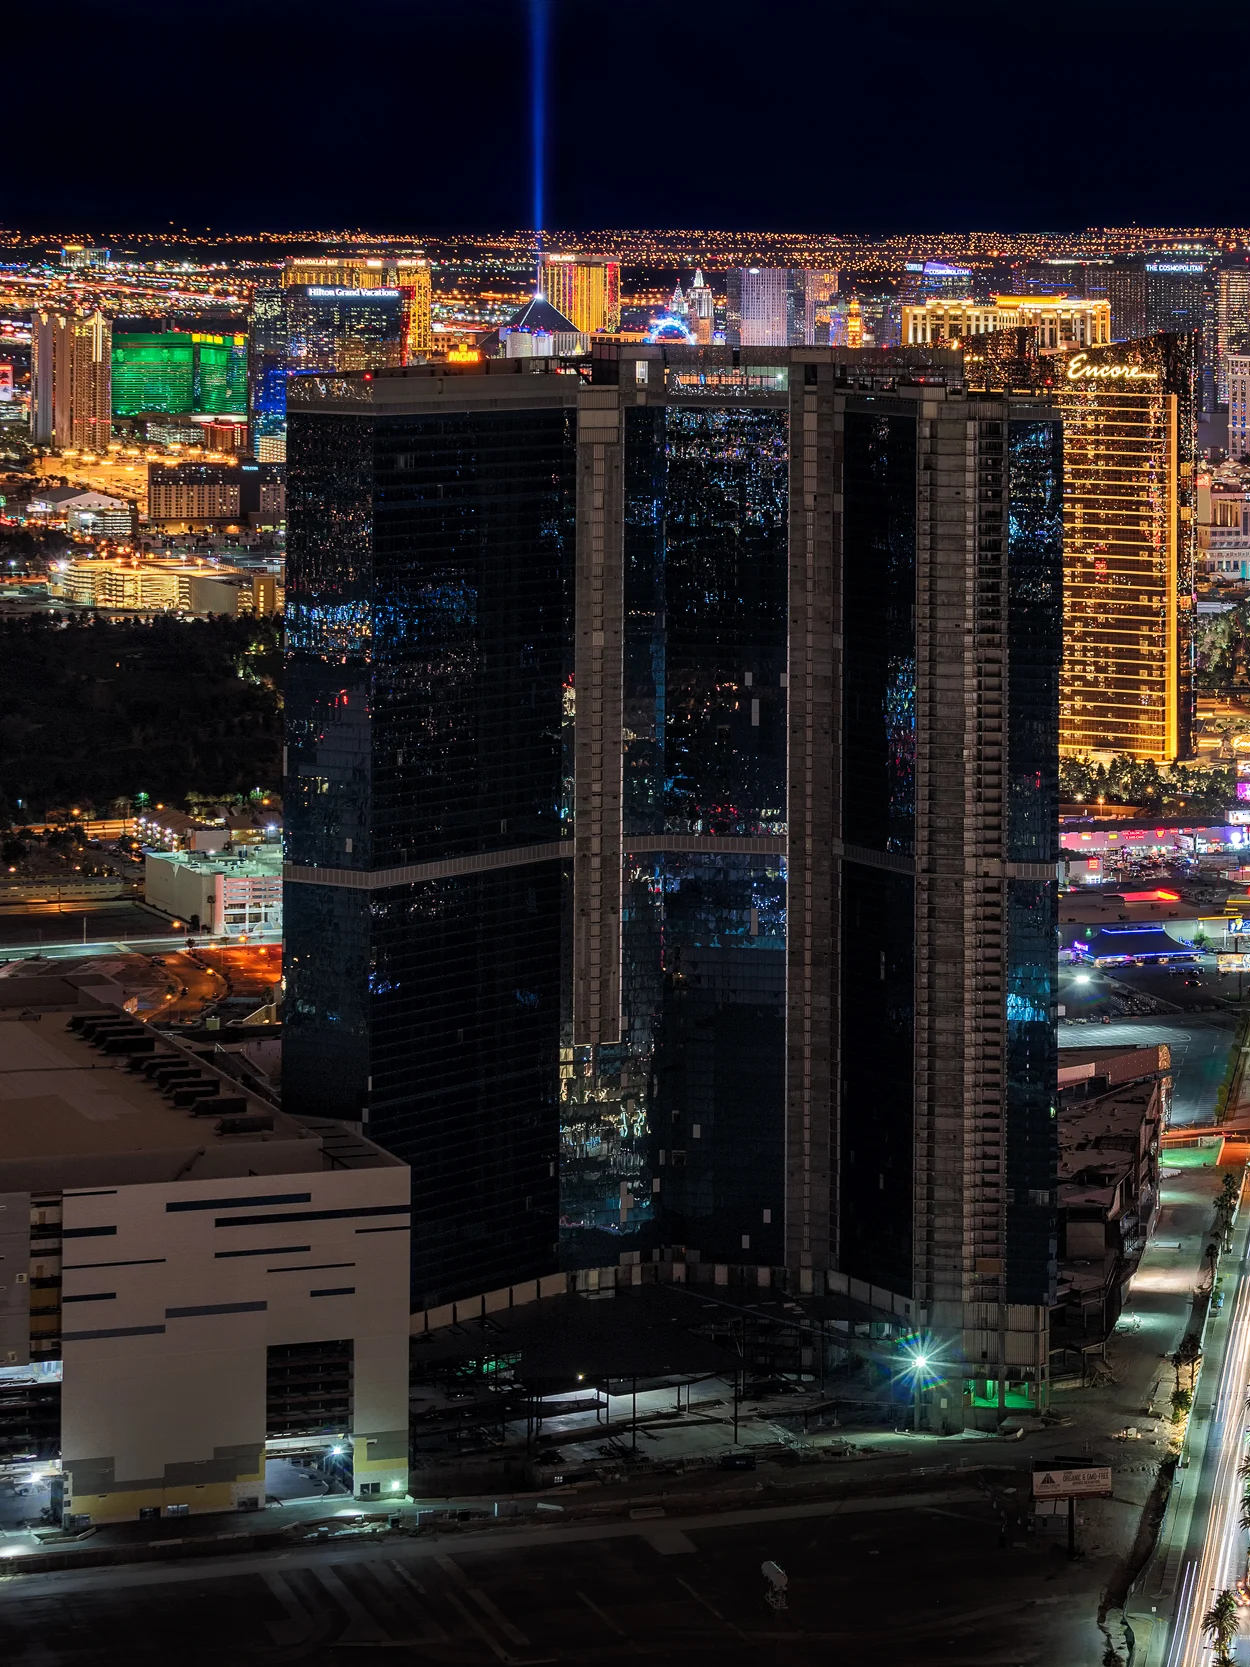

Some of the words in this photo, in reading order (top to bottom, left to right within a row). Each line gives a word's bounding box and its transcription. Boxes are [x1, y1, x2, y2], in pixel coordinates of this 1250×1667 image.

[308, 288, 334, 297] Hilton
[335, 288, 360, 297] Grand
[361, 288, 399, 297] Vacations
[448, 351, 479, 361] MGM
[1068, 353, 1158, 379] Encore
[1063, 1473, 1081, 1482] ORGANIC
[1087, 1471, 1109, 1481] GMO-FREE
